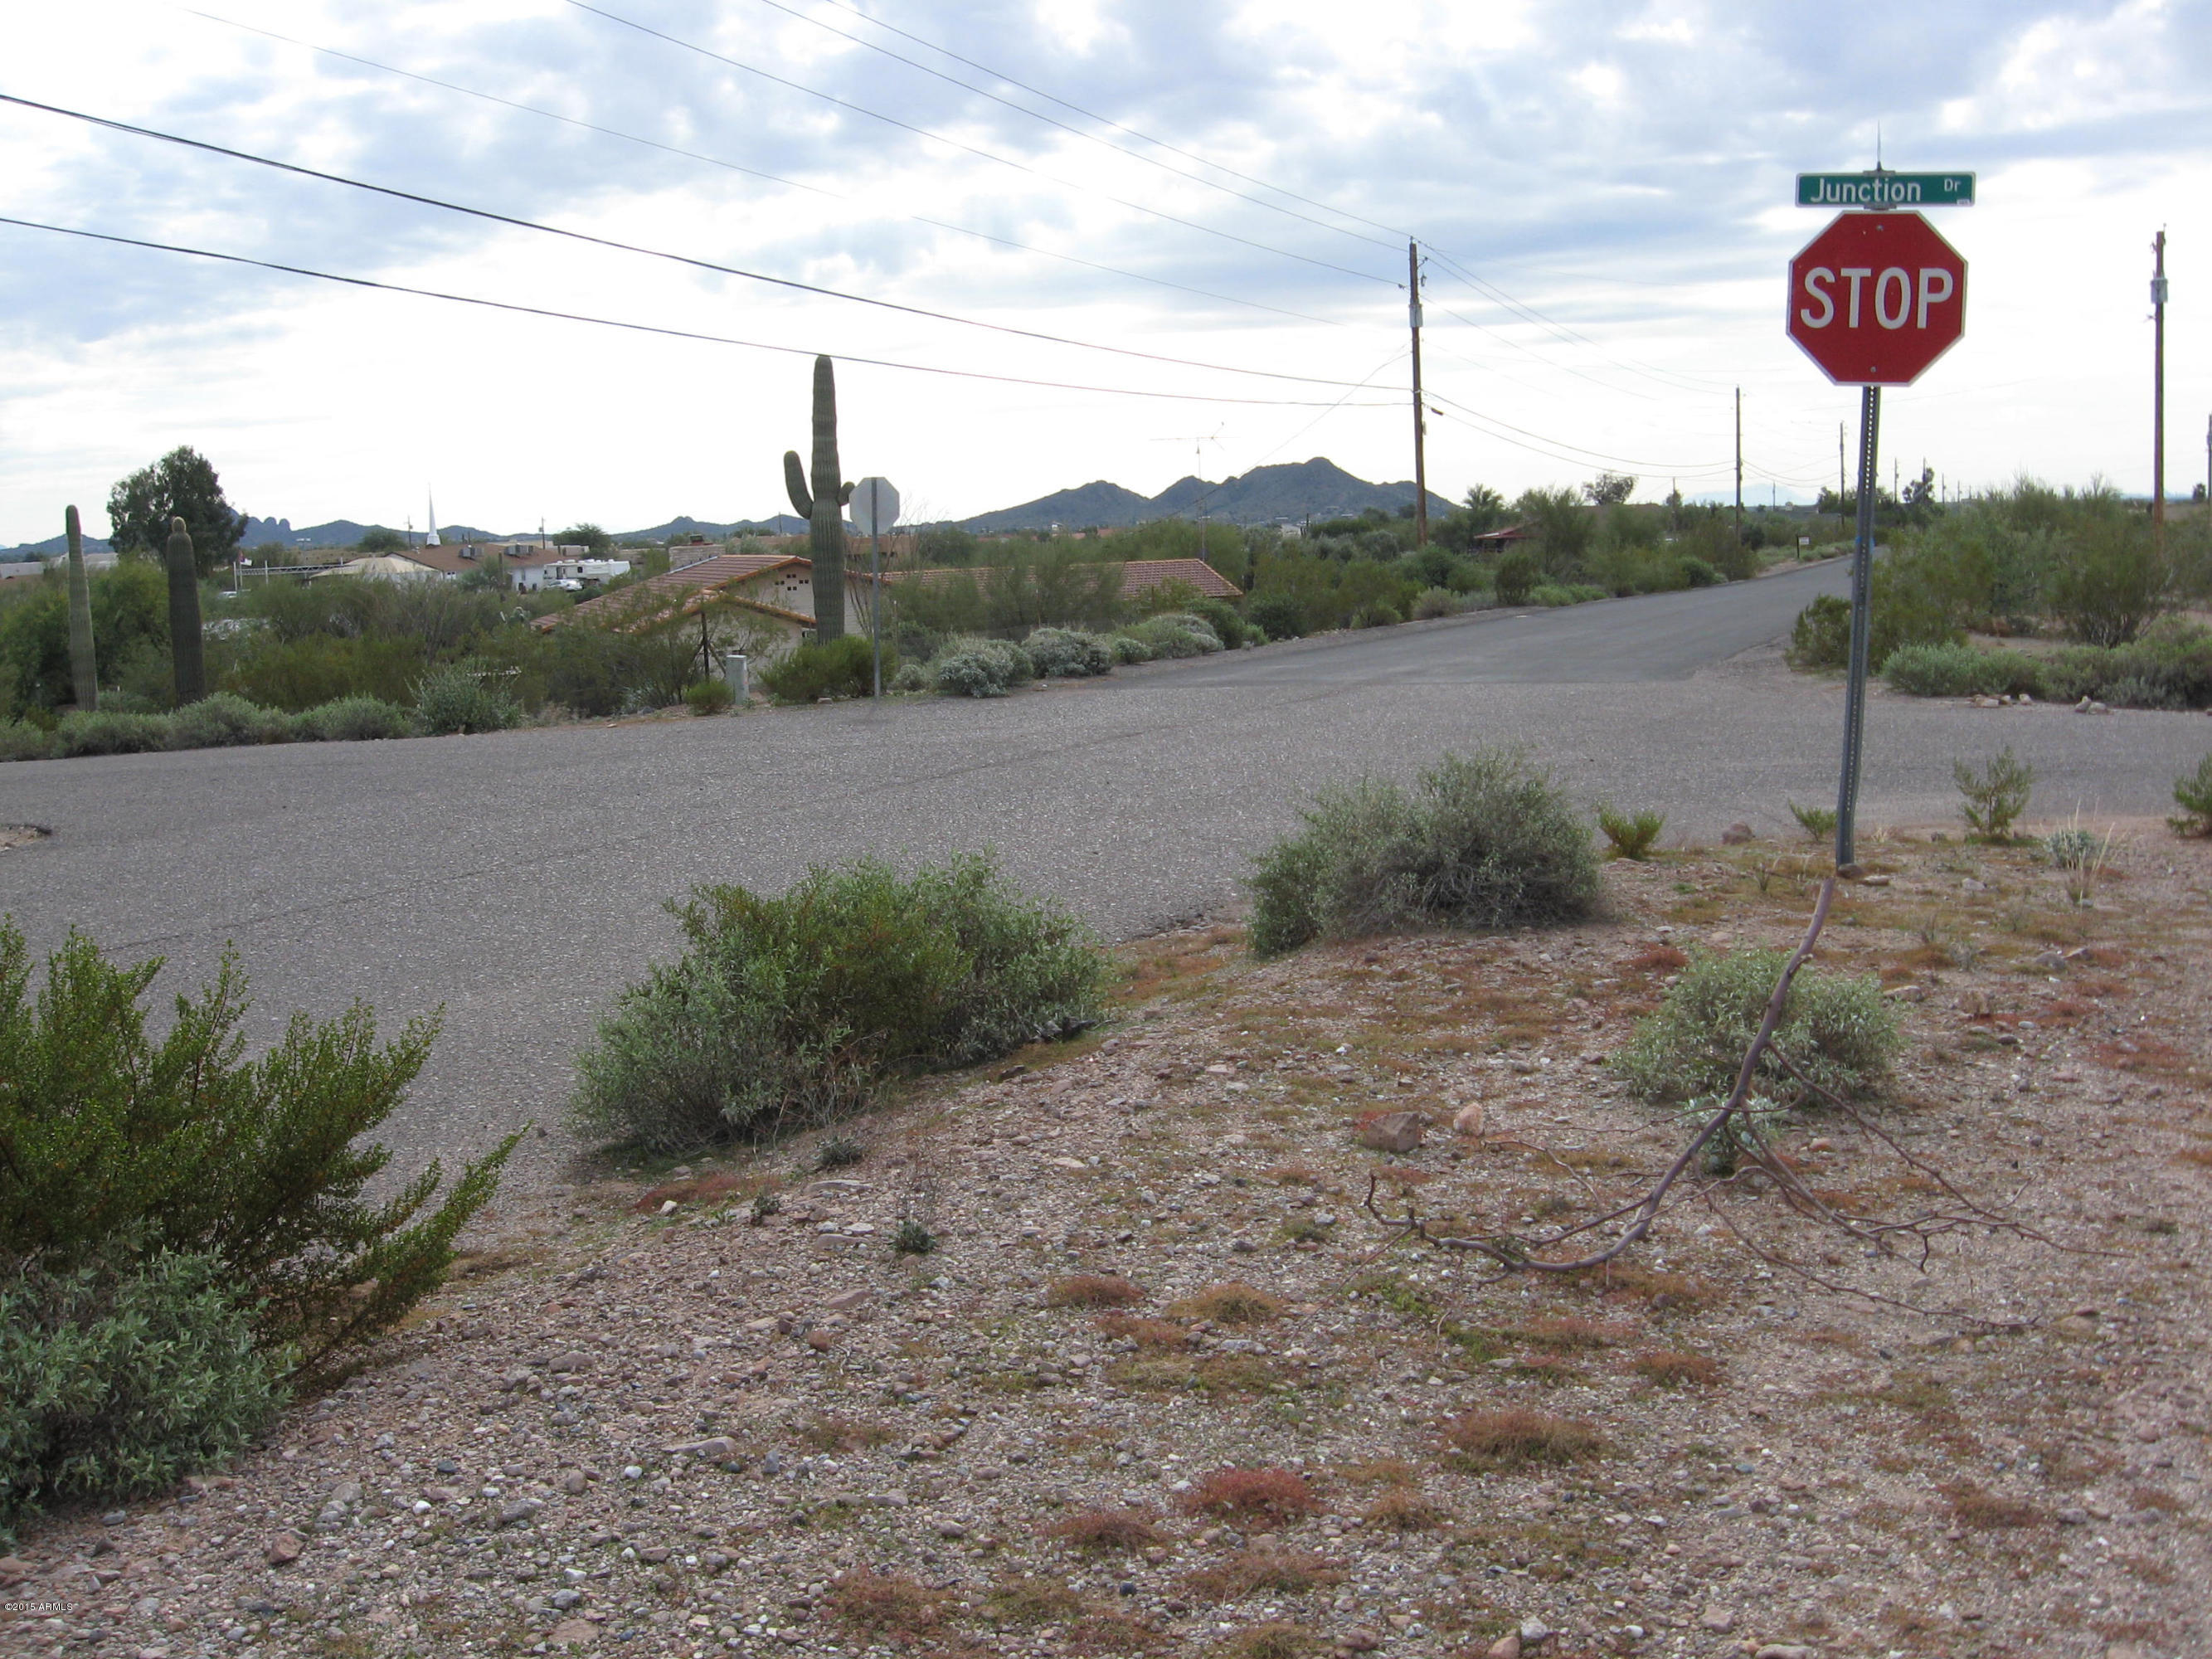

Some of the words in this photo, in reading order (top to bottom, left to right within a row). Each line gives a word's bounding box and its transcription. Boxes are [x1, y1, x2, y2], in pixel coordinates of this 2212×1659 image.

[1811, 178, 1921, 202] Junction
[1944, 178, 1961, 192] Dr
[1801, 266, 1953, 329] STOP
